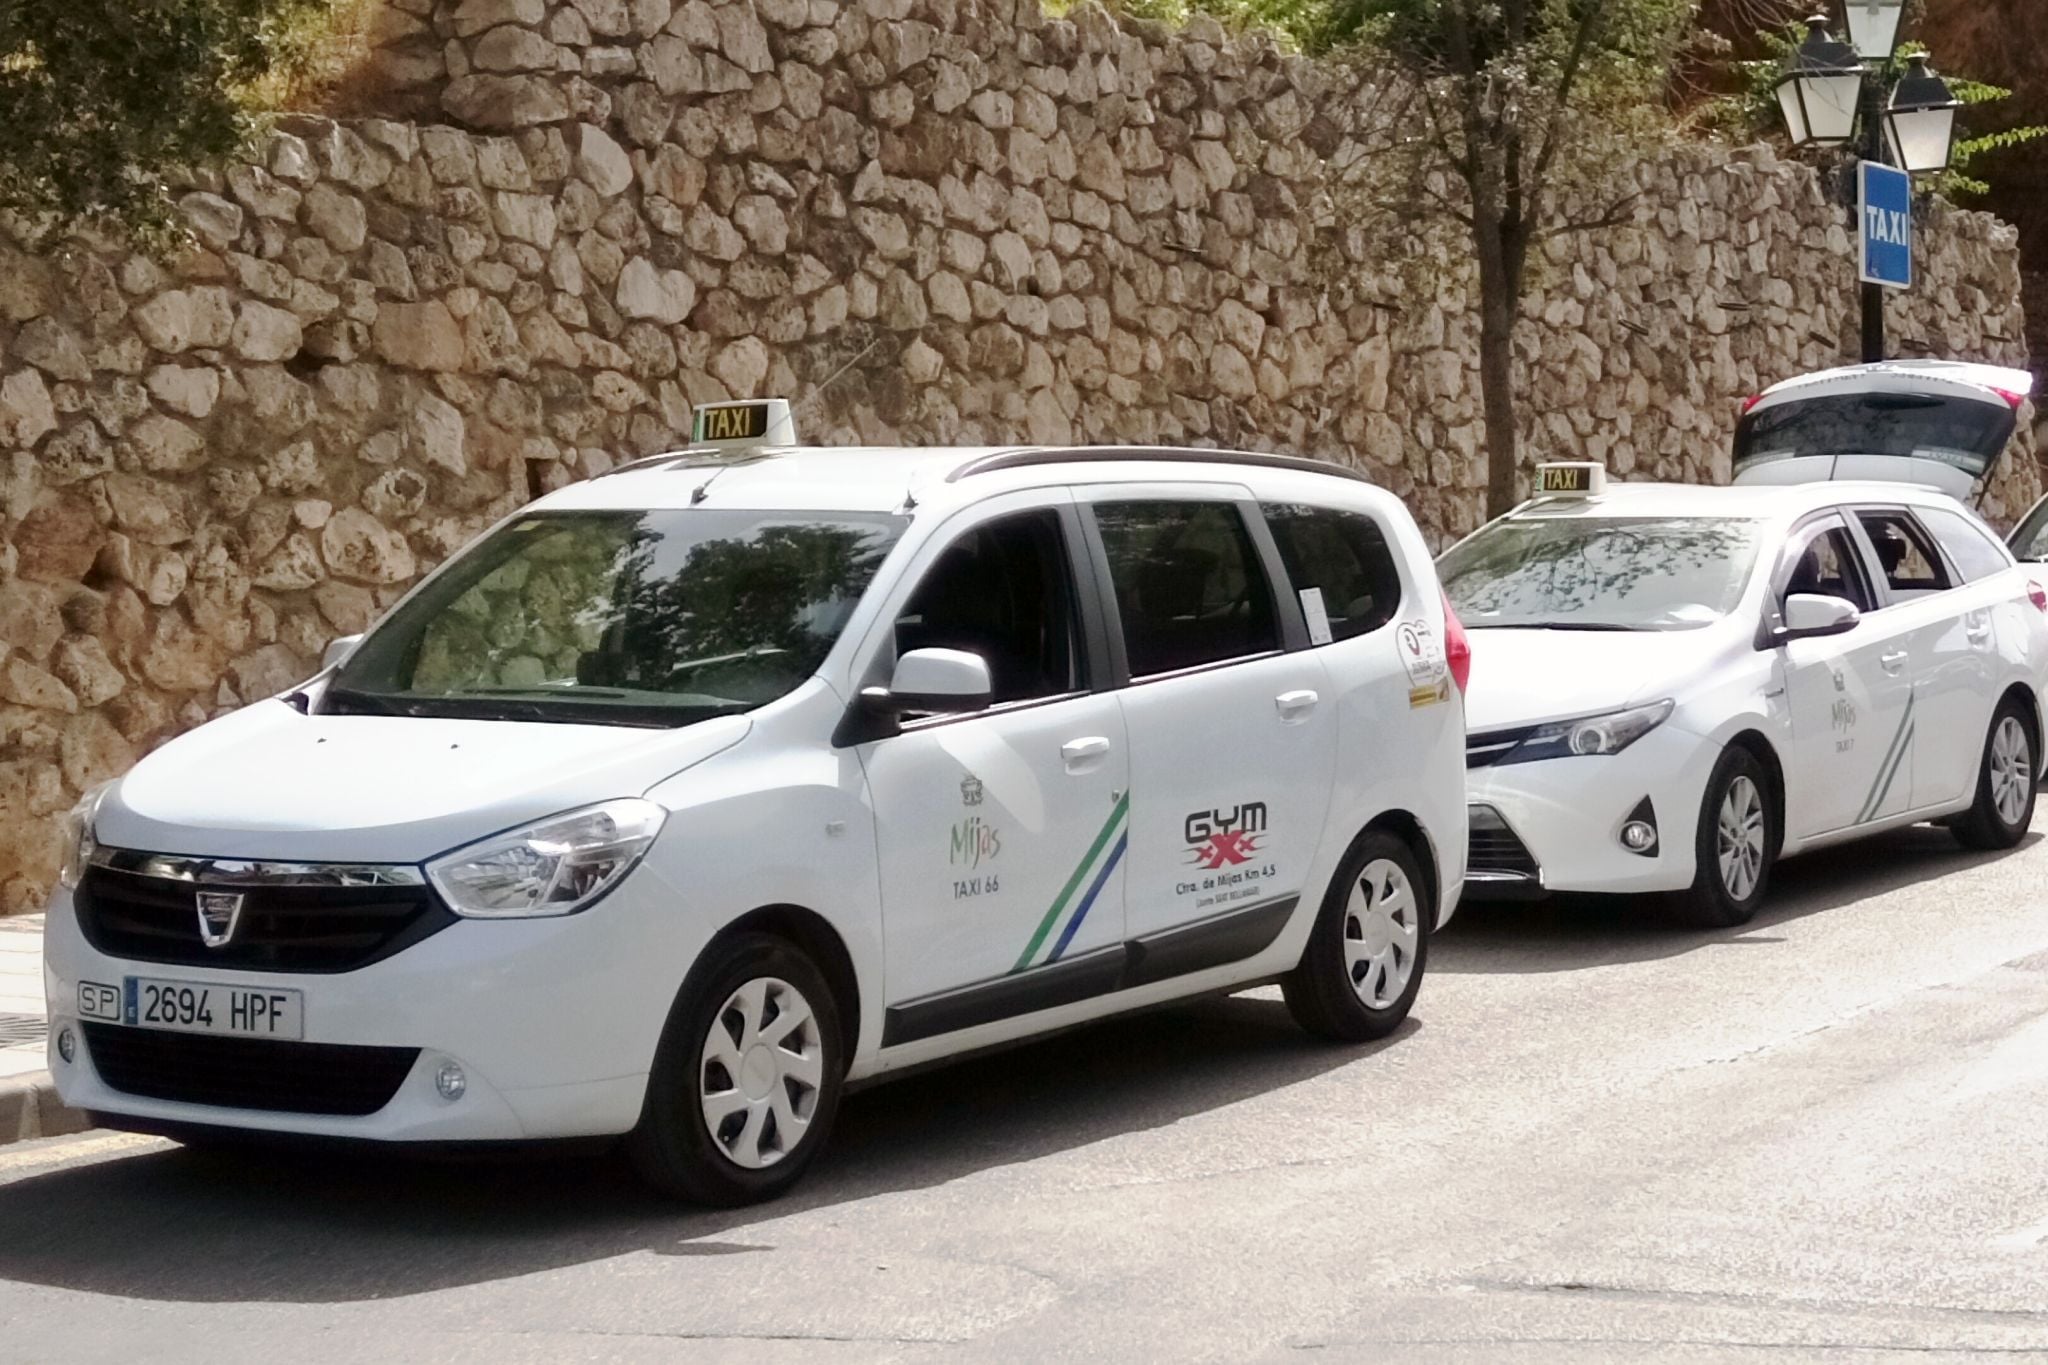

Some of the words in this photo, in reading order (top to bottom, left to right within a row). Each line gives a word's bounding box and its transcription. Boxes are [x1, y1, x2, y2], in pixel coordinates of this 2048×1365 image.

[1866, 205, 1907, 246] TAXI
[706, 408, 750, 438] TAXI
[1546, 469, 1577, 488] TAXI
[1185, 802, 1267, 844] GYM
[950, 817, 1000, 870] Mijas
[953, 879, 980, 899] TAXI
[985, 875, 999, 893] 66
[1203, 877, 1214, 889] de
[1218, 873, 1242, 887] Mijas
[1245, 870, 1259, 879] Km
[82, 987, 114, 1014] SP
[145, 985, 213, 1027] 2694
[231, 992, 287, 1032] HPF
